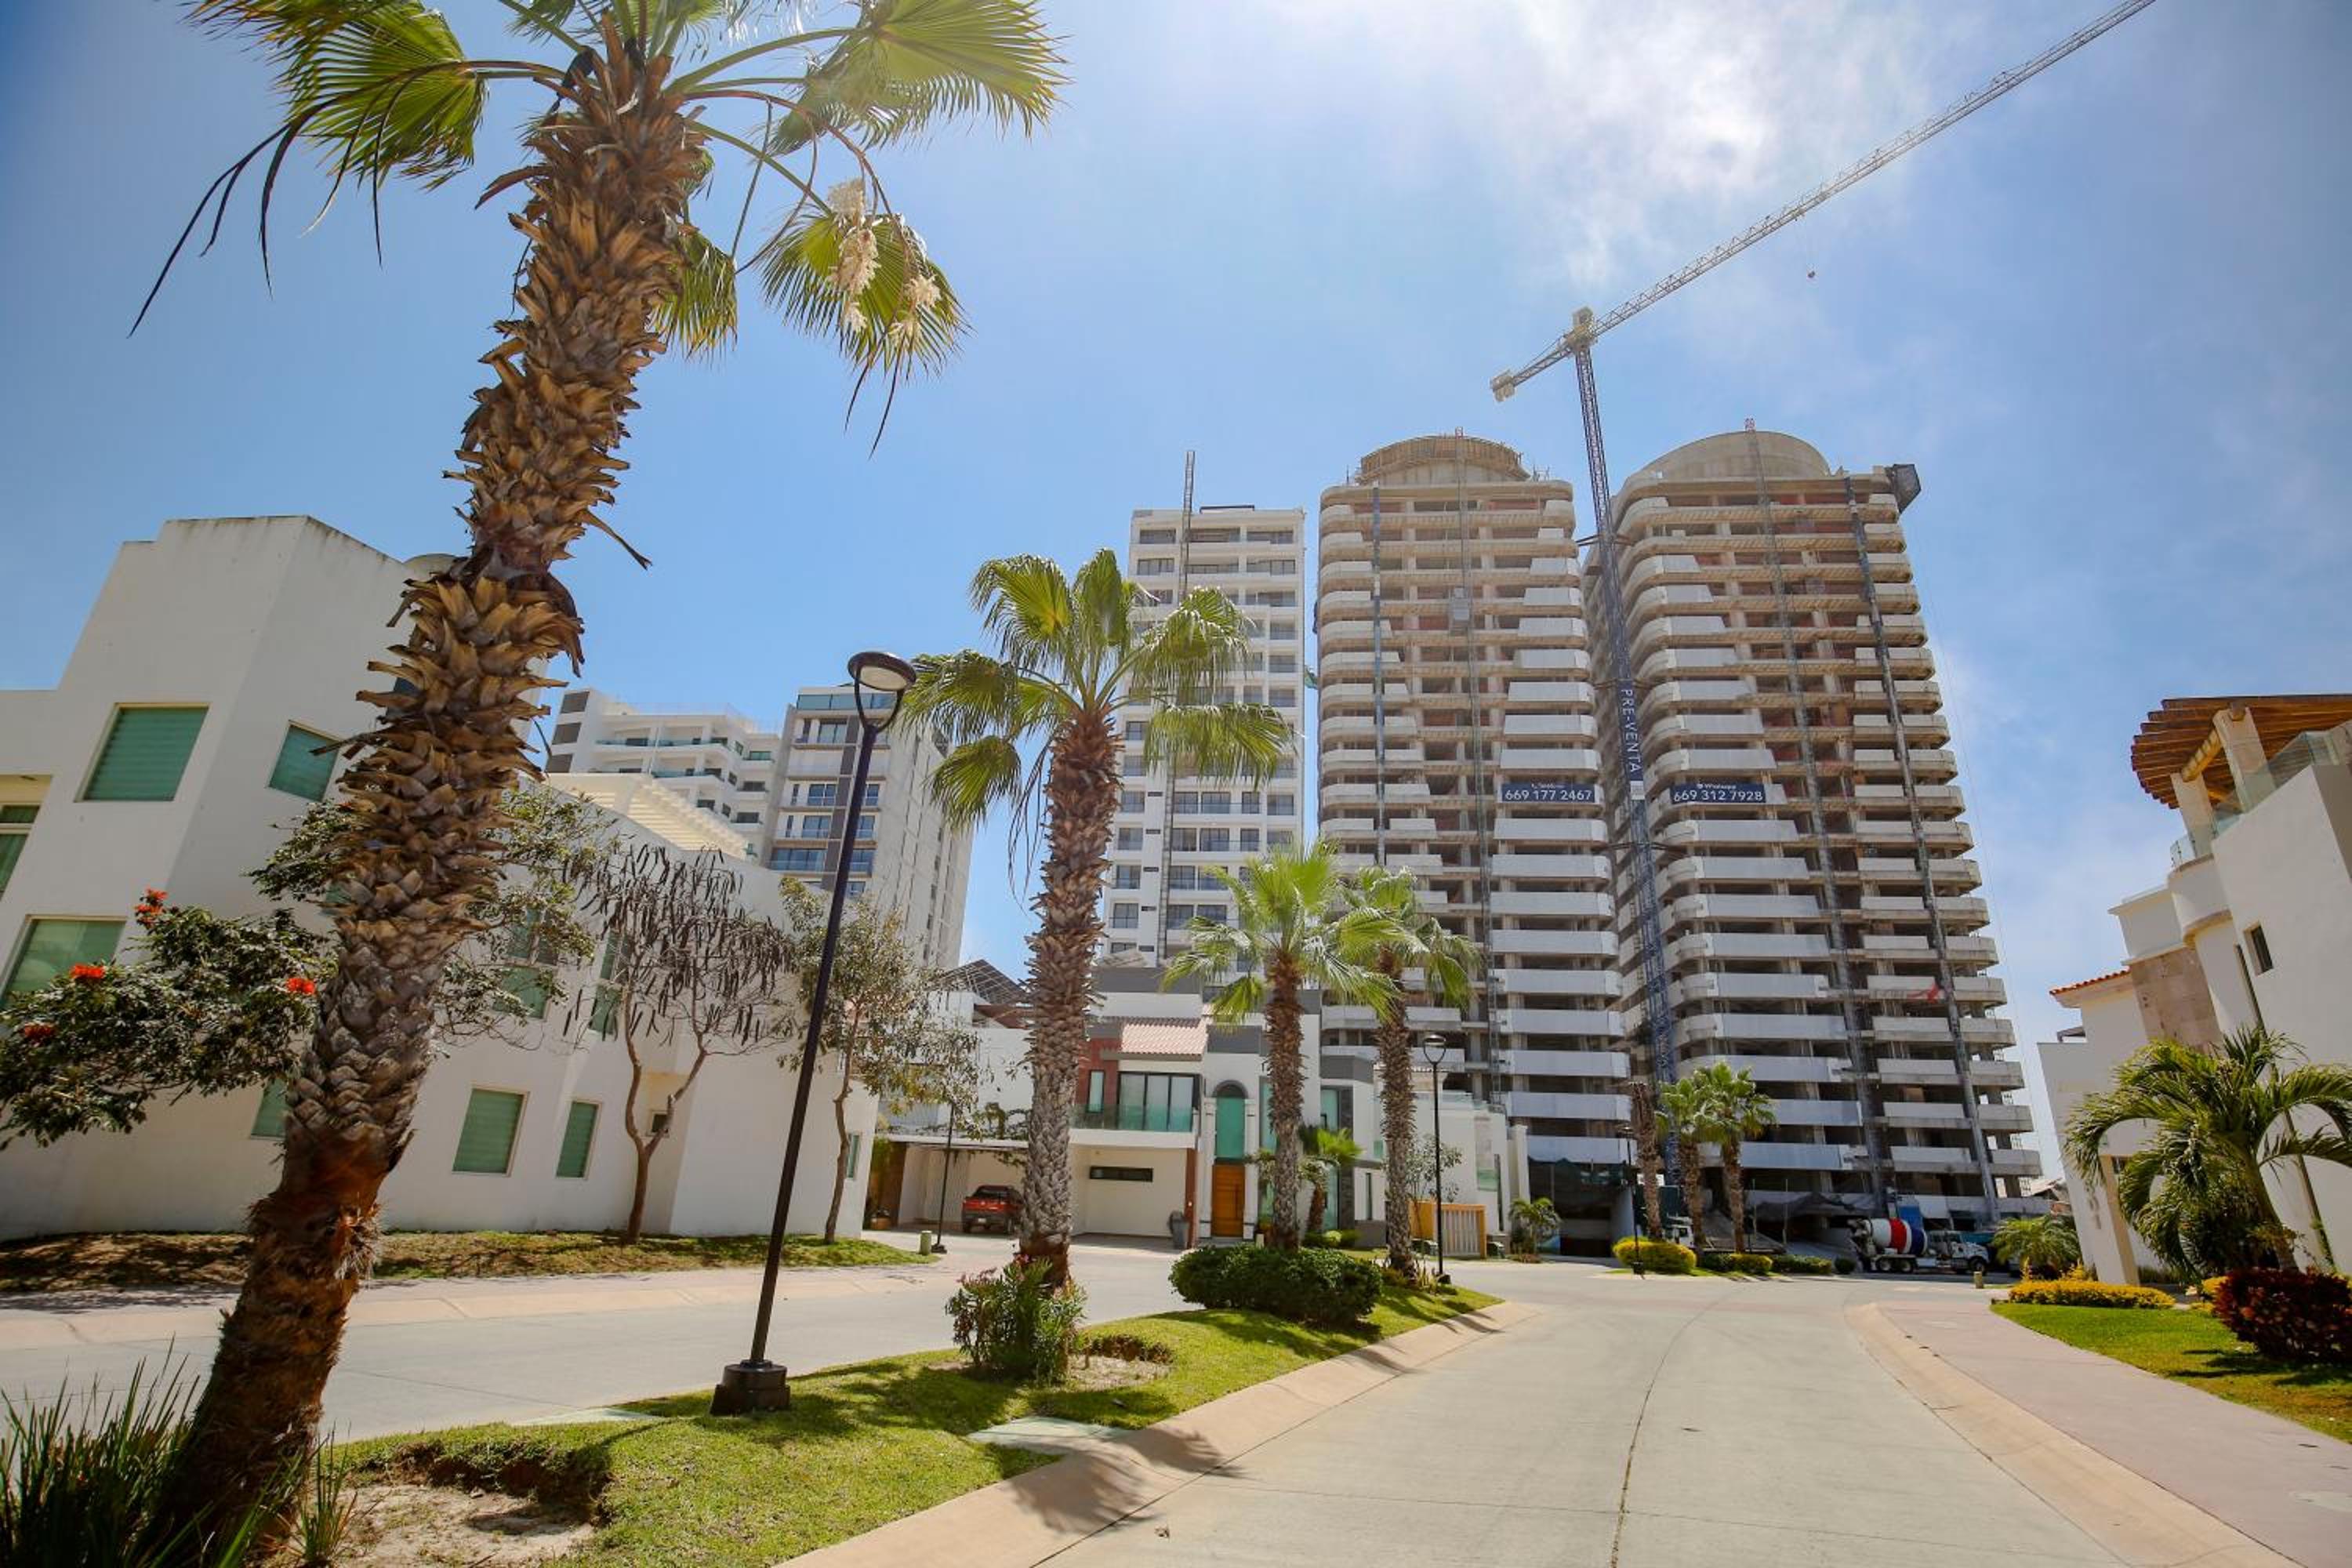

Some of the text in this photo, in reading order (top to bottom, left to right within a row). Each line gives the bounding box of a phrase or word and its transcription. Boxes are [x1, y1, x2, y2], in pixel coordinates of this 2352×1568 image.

[1621, 689, 1642, 772] PRE-VENTA
[1505, 789, 1592, 800] 669 177 2467
[1674, 789, 1763, 802] 669 312 7928
